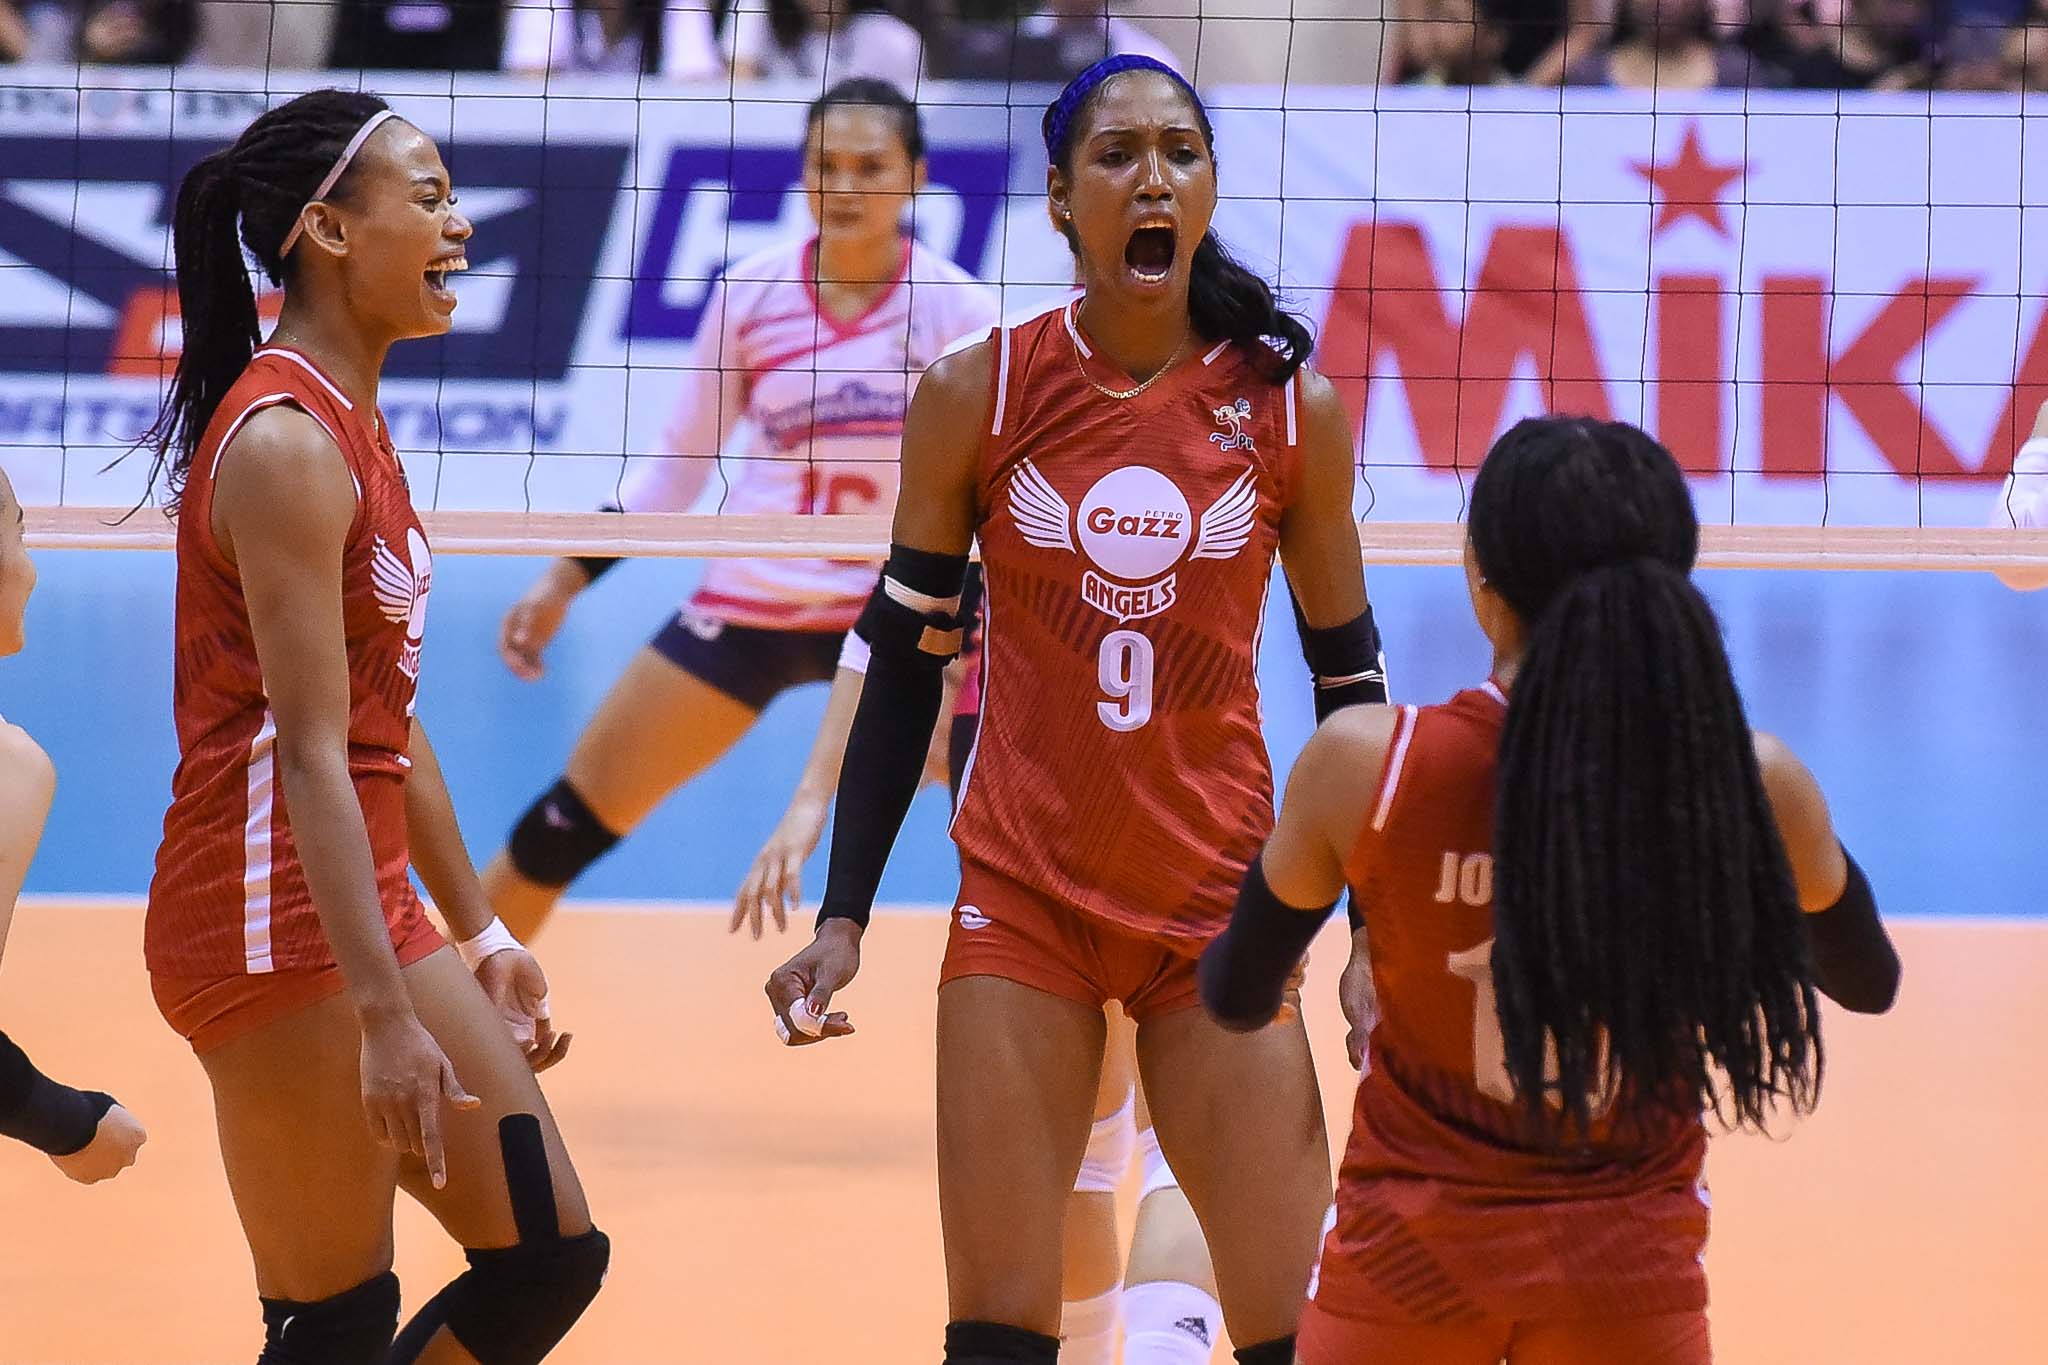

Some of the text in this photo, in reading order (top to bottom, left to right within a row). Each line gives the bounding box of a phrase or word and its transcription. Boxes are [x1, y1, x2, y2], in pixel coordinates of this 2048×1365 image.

[1087, 506, 1182, 539] Gazz
[1144, 510, 1184, 520] PETRO
[1086, 574, 1173, 618] ANGELS
[1097, 629, 1154, 732] 9
